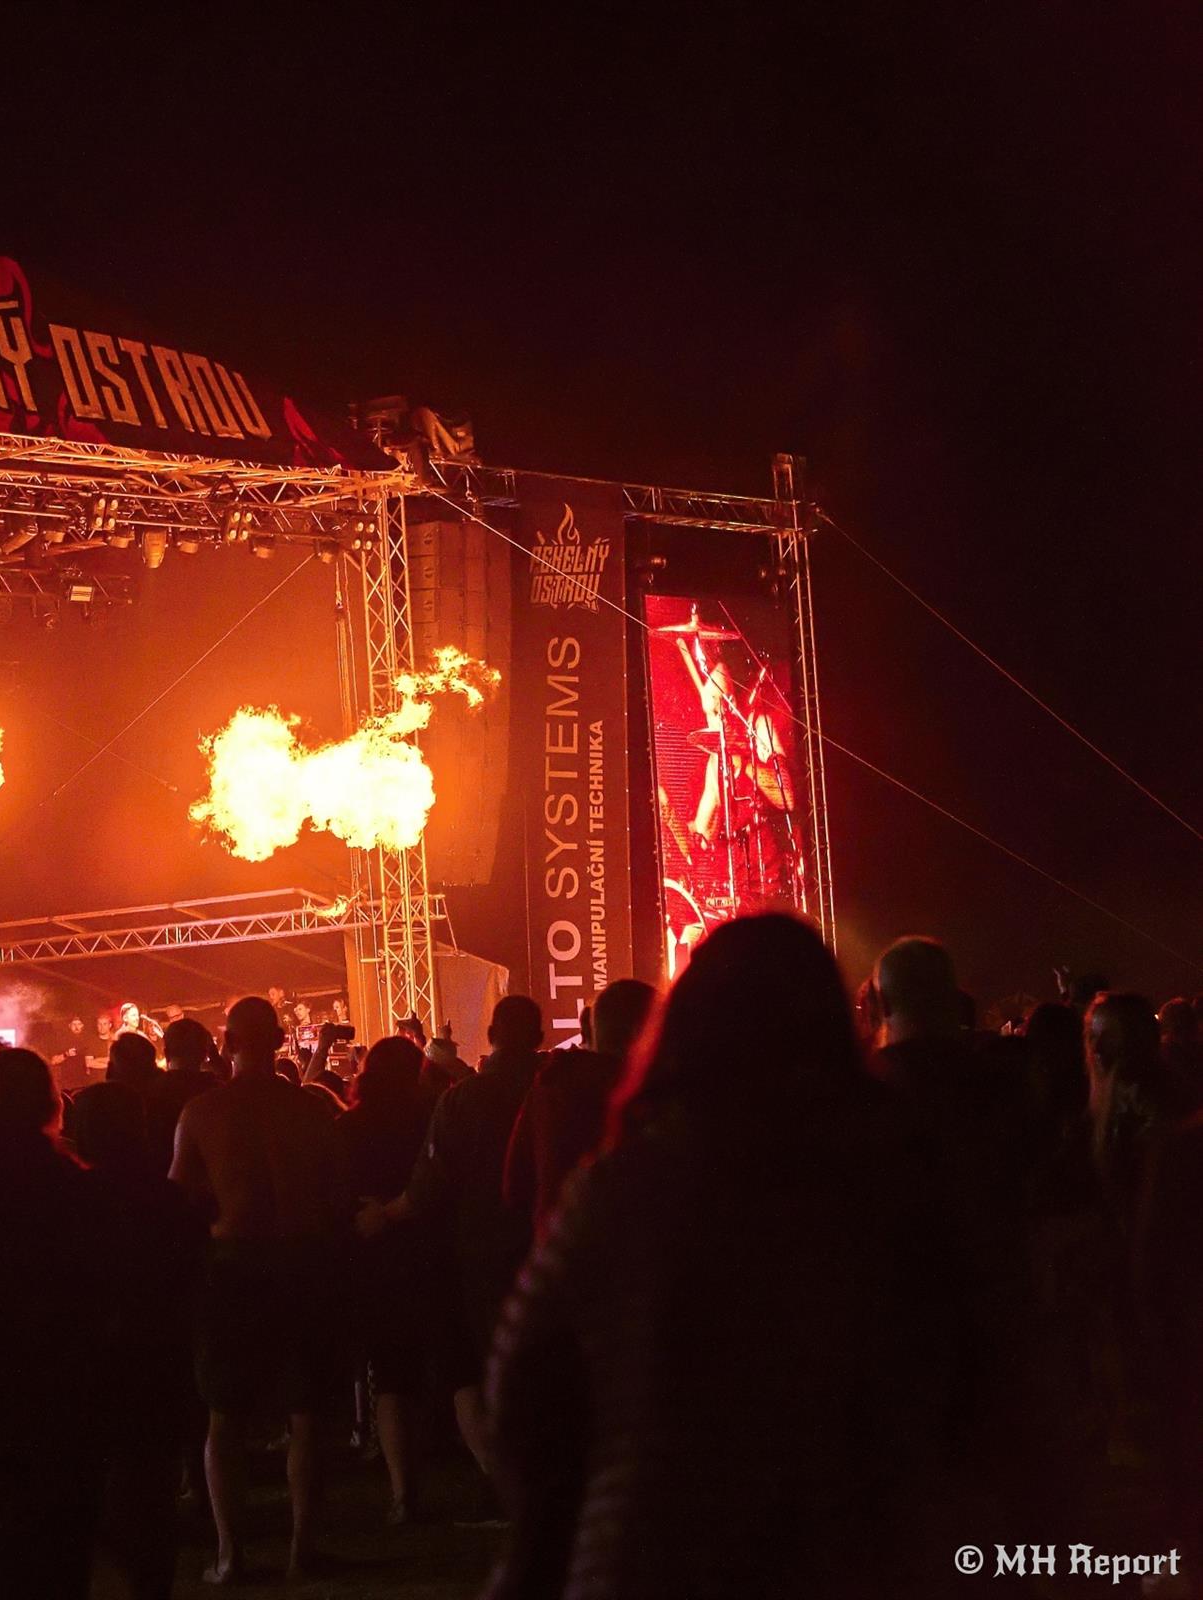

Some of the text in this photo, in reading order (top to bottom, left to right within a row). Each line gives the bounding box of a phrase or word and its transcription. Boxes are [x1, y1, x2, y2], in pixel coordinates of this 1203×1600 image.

[544, 636, 581, 900] SYSTEMS
[586, 720, 608, 991] MANIPULAČNÍ TECHNIKA
